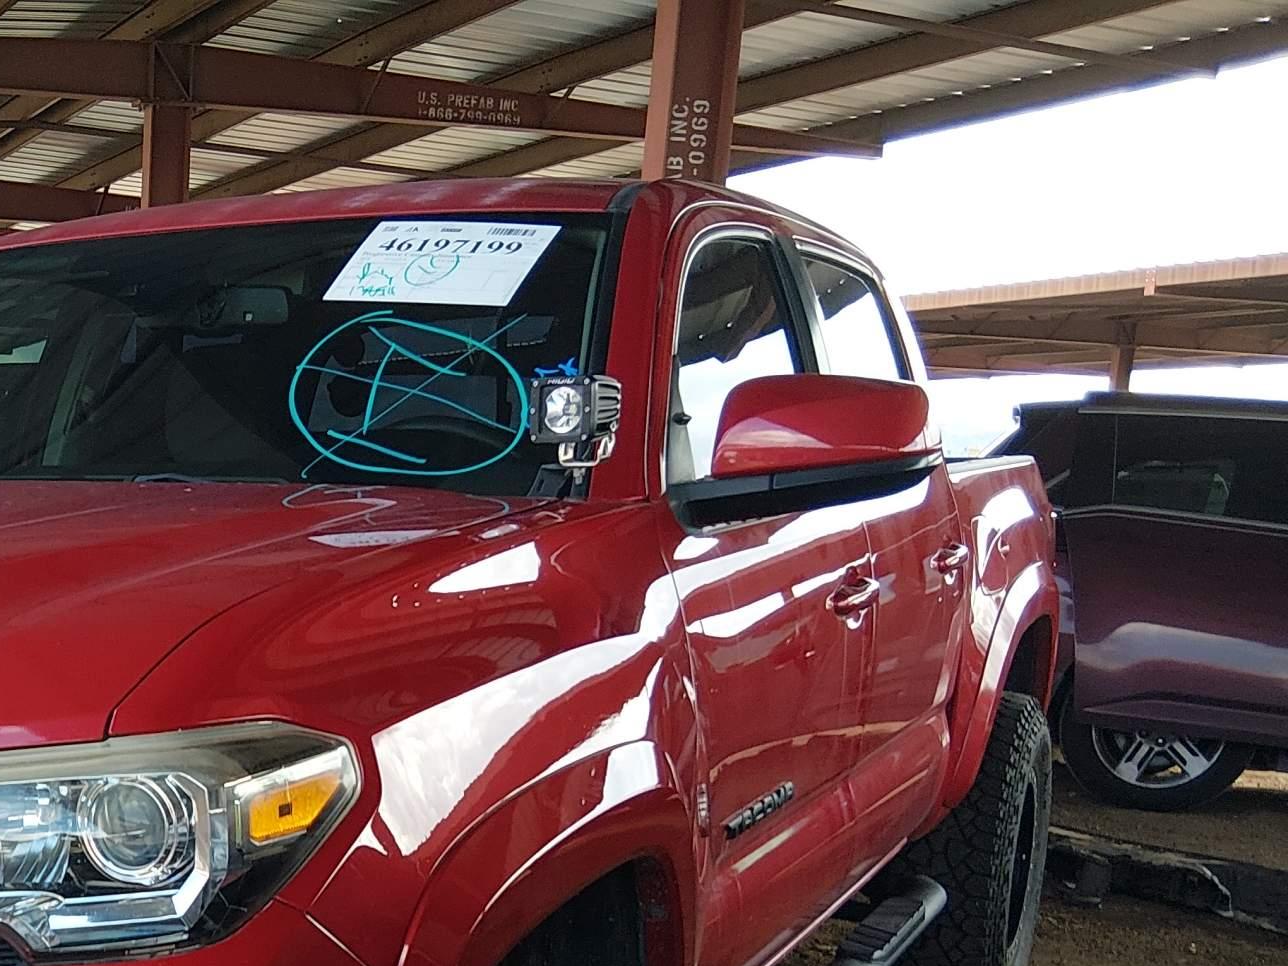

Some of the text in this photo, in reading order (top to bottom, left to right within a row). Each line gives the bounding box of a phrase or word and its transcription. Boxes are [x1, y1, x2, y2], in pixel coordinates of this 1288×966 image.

[417, 91, 441, 105] U.S.
[447, 94, 494, 109] PREFAB
[670, 97, 690, 142] INC.
[378, 237, 524, 255] 46197199
